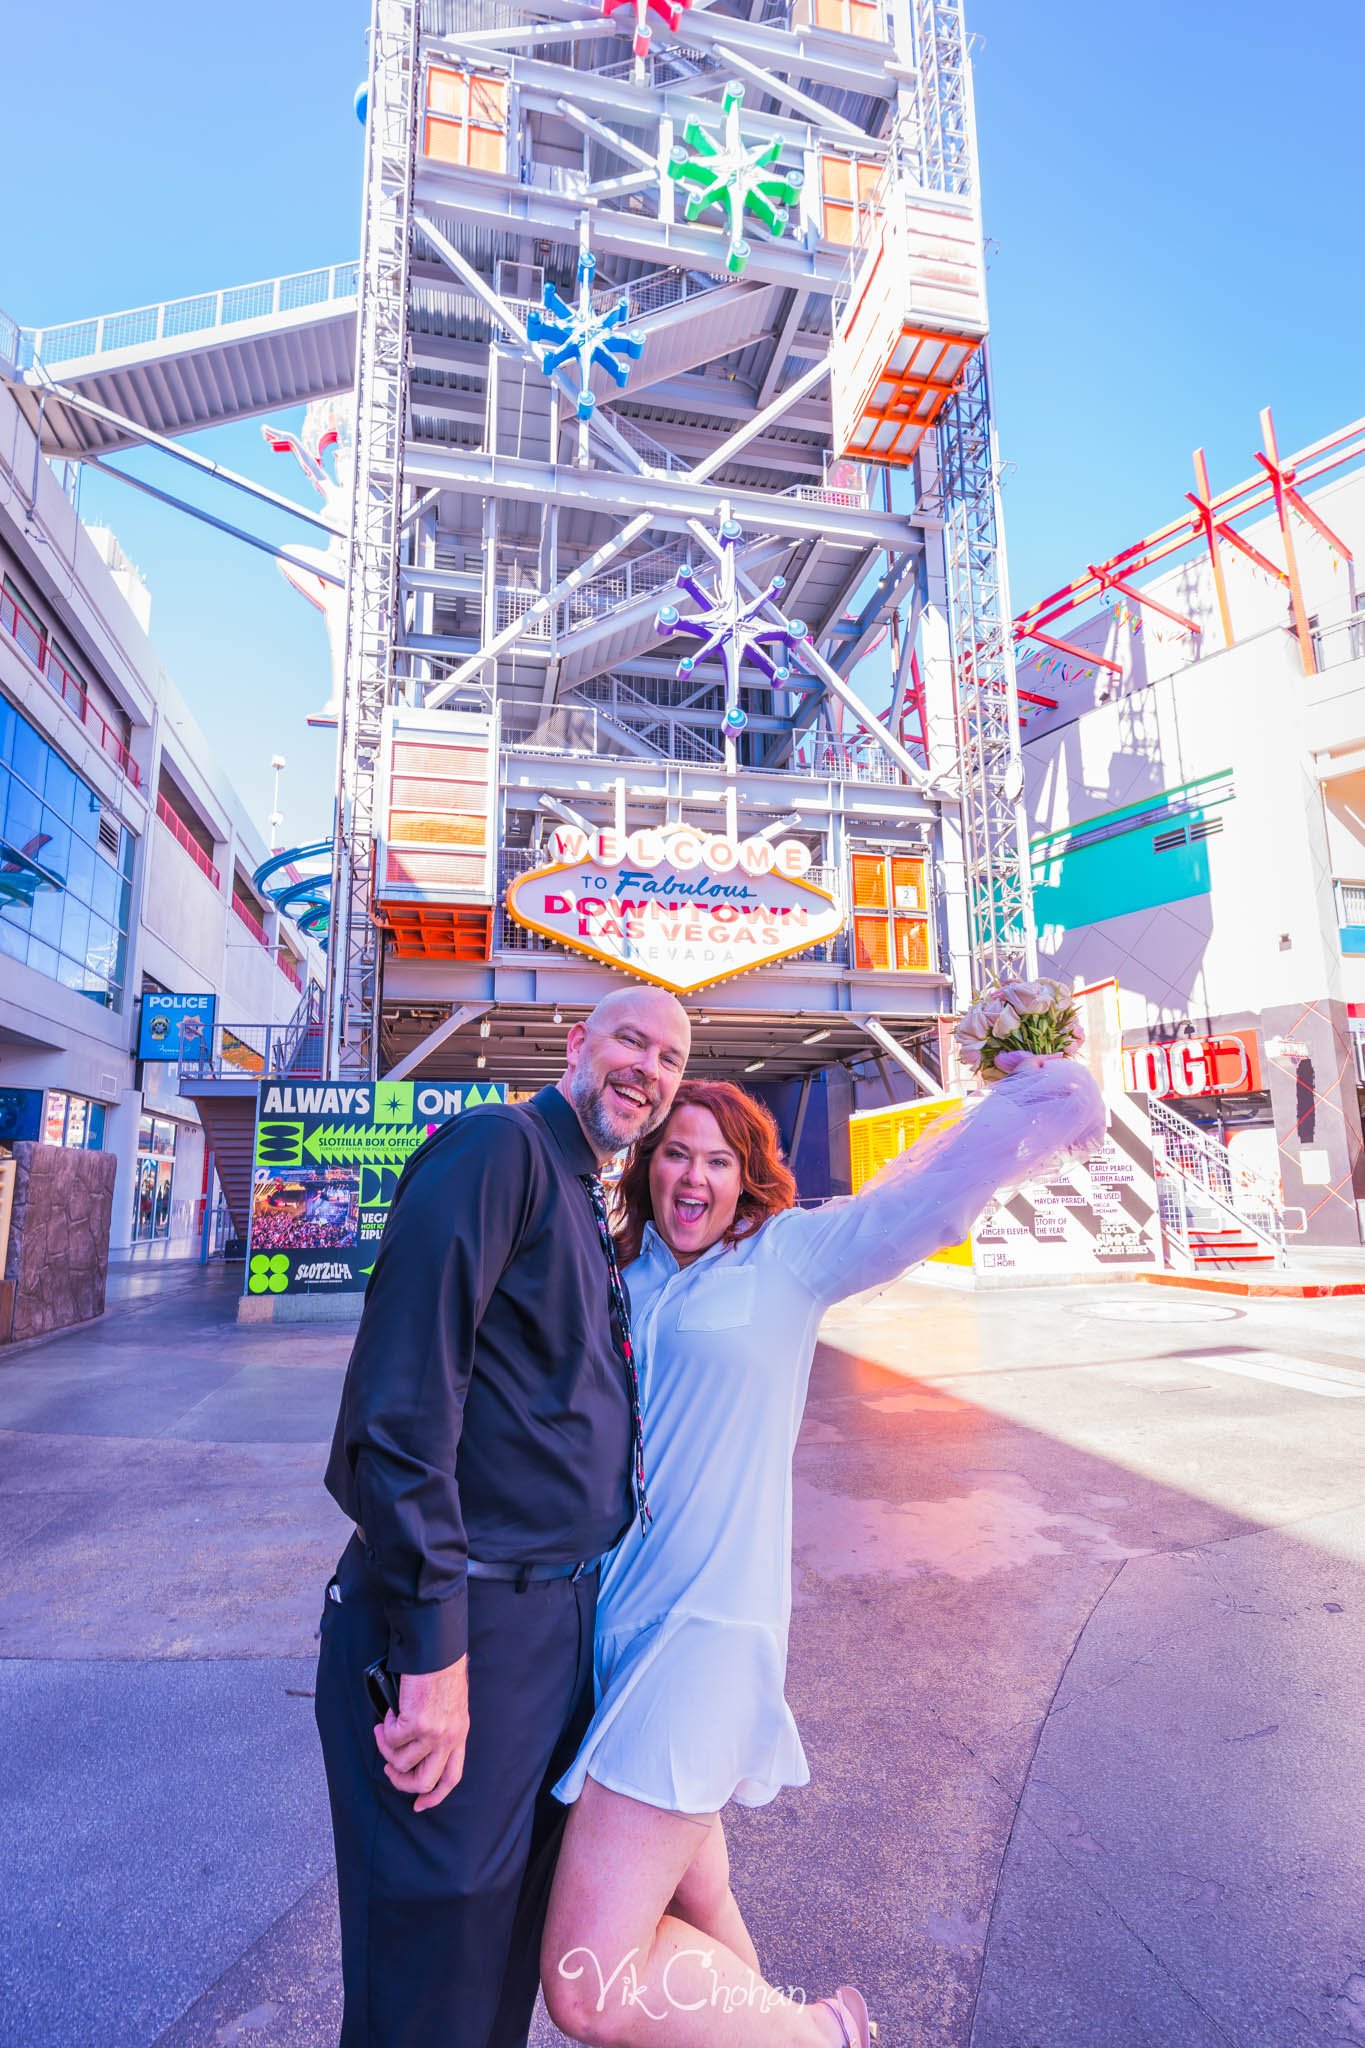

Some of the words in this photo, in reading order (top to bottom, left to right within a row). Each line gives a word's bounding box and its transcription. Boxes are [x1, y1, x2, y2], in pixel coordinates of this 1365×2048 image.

[555, 832, 802, 869] WELCOME
[582, 876, 607, 890] TO
[615, 870, 757, 898] Fabulous
[544, 894, 808, 926] DOWNTOWN
[578, 918, 645, 939] LAS
[660, 922, 781, 945] VEGAS
[150, 997, 208, 1009] POLICE
[264, 1087, 370, 1114] ALWAYS
[417, 1089, 461, 1114] ON
[318, 1137, 362, 1147] SLOTZILLA
[365, 1138, 385, 1147] BOX
[388, 1138, 420, 1147] OFFICE
[294, 1262, 353, 1280] SLOTZILLA
